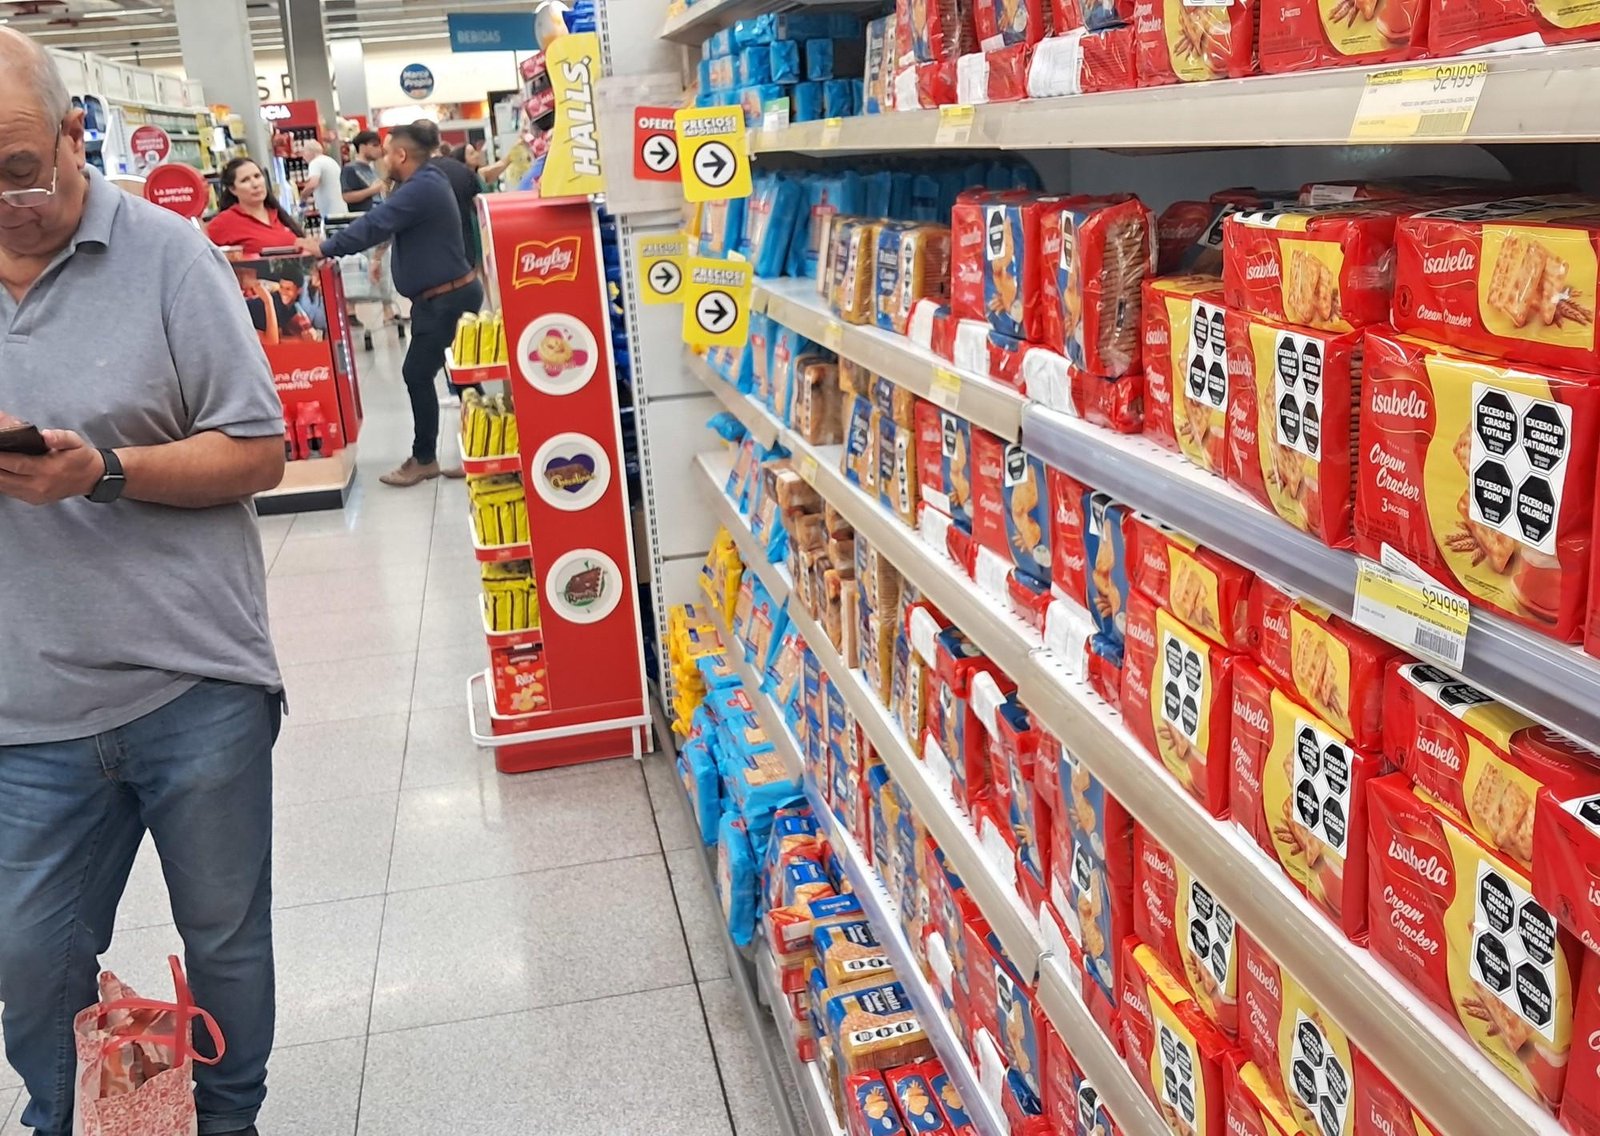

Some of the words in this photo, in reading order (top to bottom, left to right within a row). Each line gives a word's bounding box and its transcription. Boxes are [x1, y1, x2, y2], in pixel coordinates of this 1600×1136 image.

[457, 30, 501, 43] BEBIDAS
[521, 248, 573, 275] Bagley
[1423, 247, 1475, 274] isabela
[1416, 304, 1443, 322] Cream
[1443, 308, 1472, 328] Cracker
[1371, 386, 1428, 419] isabela
[1479, 405, 1504, 419] EXCESO
[1505, 411, 1515, 422] EN
[1481, 426, 1512, 441] TOTALES
[1483, 416, 1511, 431] GRASAS
[1525, 417, 1552, 432] EXCESO
[1553, 425, 1563, 435] EN
[1522, 438, 1563, 458] SATURADAS
[1530, 430, 1558, 445] GRASAS
[1369, 442, 1406, 474] Cream
[1376, 467, 1419, 502] Cracker
[1476, 478, 1502, 493] EXCESO
[1502, 486, 1511, 497] EN
[1381, 498, 1388, 512] 3
[1483, 490, 1504, 504] SODIO
[1519, 494, 1543, 510] EXCESO
[1543, 503, 1553, 514] EN
[1520, 504, 1550, 524] CALORÍAS
[1233, 694, 1269, 733] isabela
[1416, 731, 1460, 771] isabela
[1388, 834, 1449, 887] isabela
[1383, 885, 1425, 925] Cream
[1483, 880, 1505, 900] EXCESO
[1505, 896, 1513, 908] EN
[1487, 893, 1509, 914] GRASAS
[1485, 900, 1510, 925] TOTALES
[1521, 909, 1546, 930] EXCESO
[1546, 926, 1555, 939] EN
[1390, 910, 1439, 955] Cracker
[1525, 921, 1550, 944] GRASAS
[1480, 943, 1501, 965] EXCESO
[1500, 960, 1510, 972] EN
[1485, 956, 1503, 975] SODIO
[1246, 953, 1279, 1001] isabela
[1518, 974, 1541, 996] EXCESO
[1540, 992, 1551, 1005] EN
